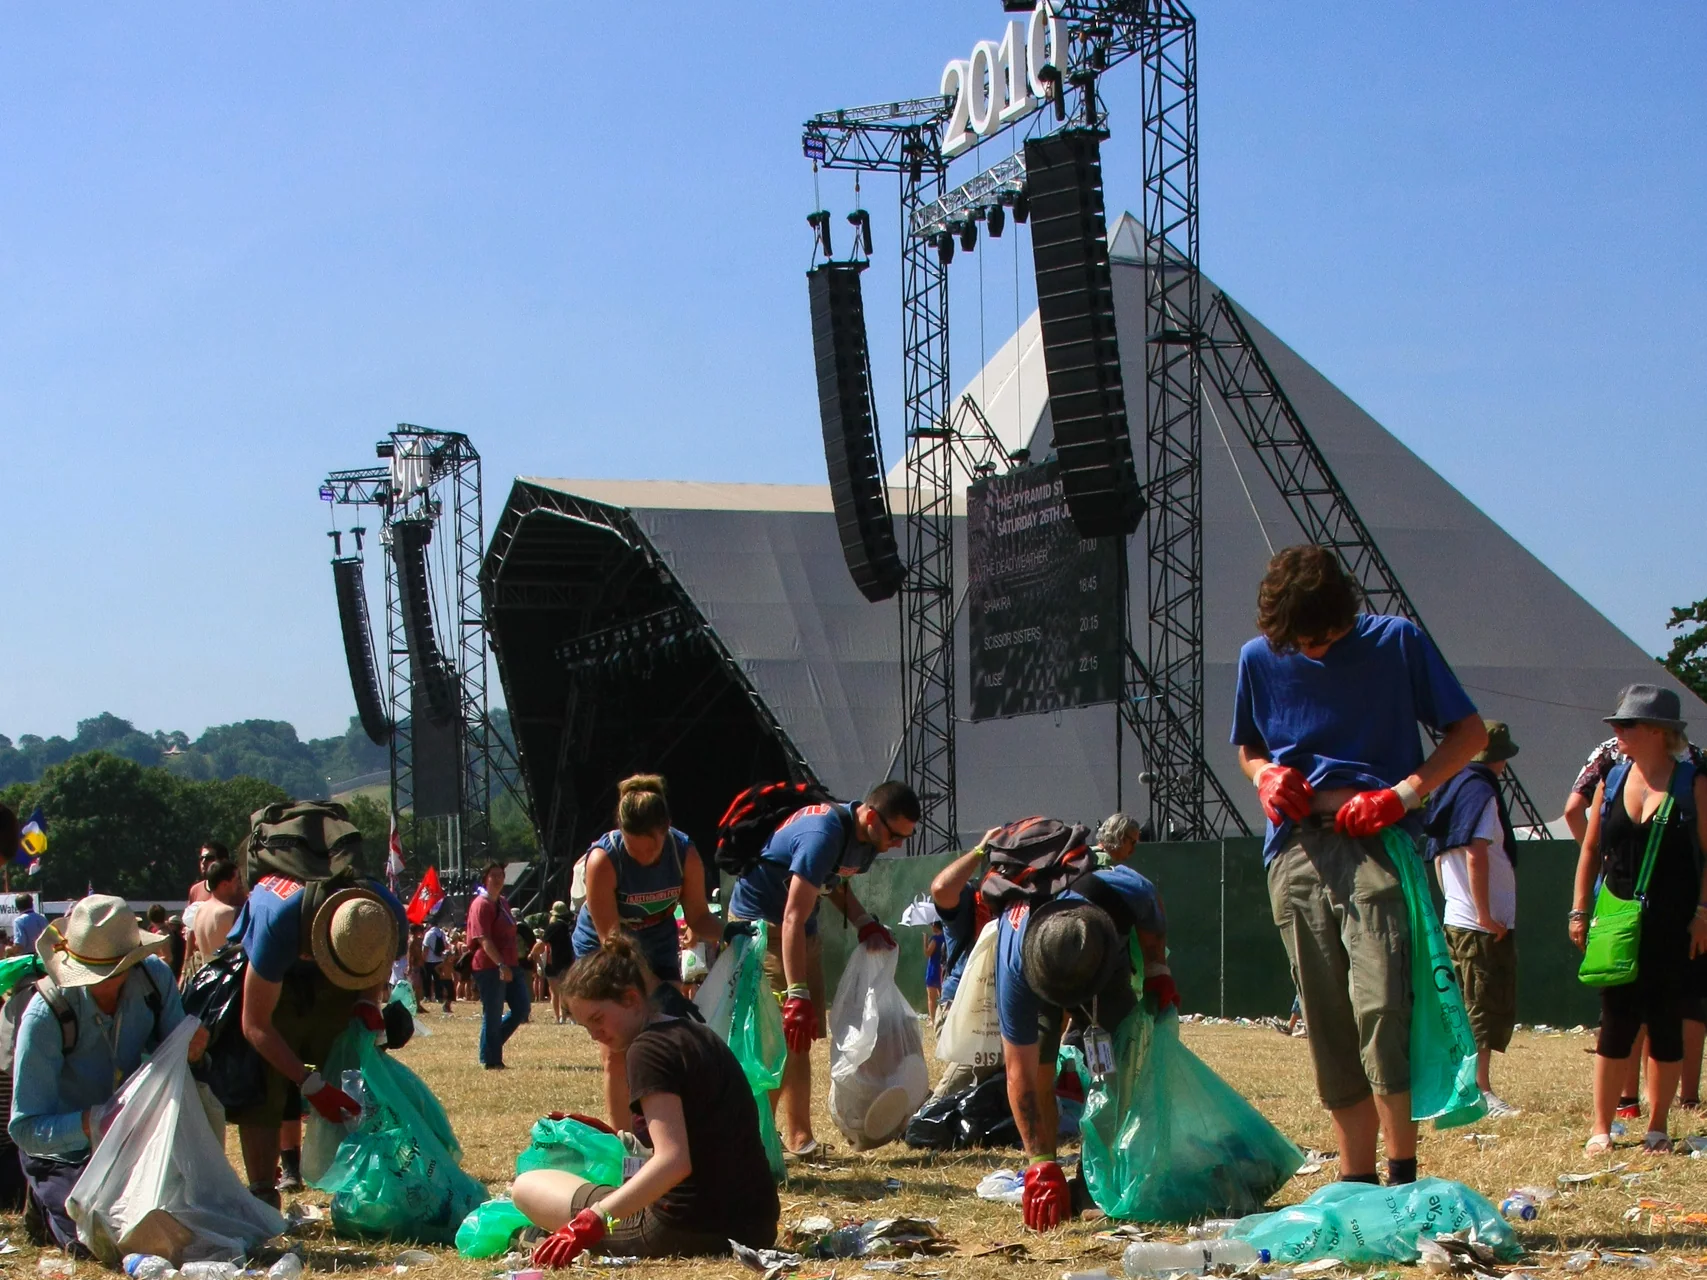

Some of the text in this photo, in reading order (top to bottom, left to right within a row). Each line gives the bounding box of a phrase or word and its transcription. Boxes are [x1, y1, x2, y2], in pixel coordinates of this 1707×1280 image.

[940, 0, 1068, 157] 2010
[996, 479, 1064, 513] THE PYRAMID ST
[996, 503, 1072, 537] SATURDAY 26TH JU
[996, 554, 1014, 575] DEAD
[1014, 548, 1049, 571] WEATHER
[983, 576, 1097, 615] SHAKIRA 18:45
[983, 615, 1099, 651] SCISSOR SISTERS 20:15
[984, 655, 1099, 688] MUSE 22:15
[1, 904, 19, 914] Wate
